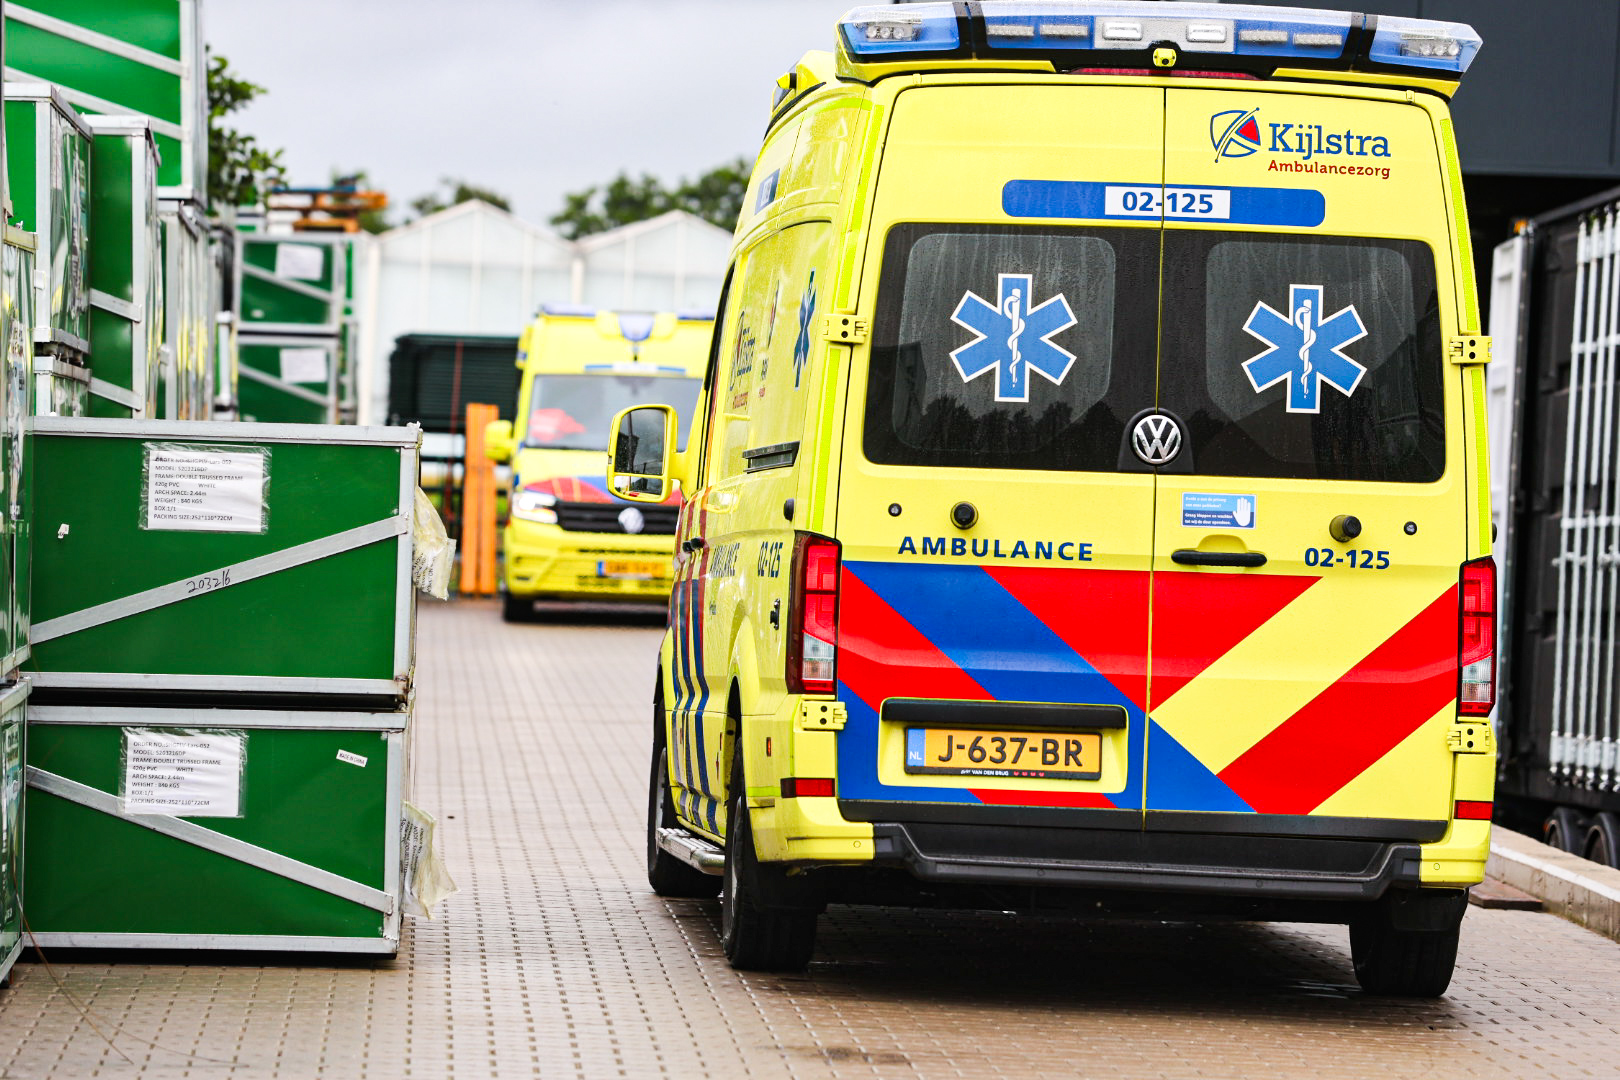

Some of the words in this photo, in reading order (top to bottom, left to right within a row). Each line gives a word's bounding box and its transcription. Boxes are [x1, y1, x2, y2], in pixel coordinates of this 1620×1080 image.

[1268, 122, 1391, 160] Kijlstra
[1268, 159, 1391, 180] Ambulancezorg
[1121, 190, 1214, 214] 02-125
[898, 535, 1094, 562] AMBULANCE
[1304, 547, 1391, 570] 02-125
[186, 569, 231, 593] 203216
[908, 751, 922, 761] NL
[938, 734, 1083, 766] J-637-BR
